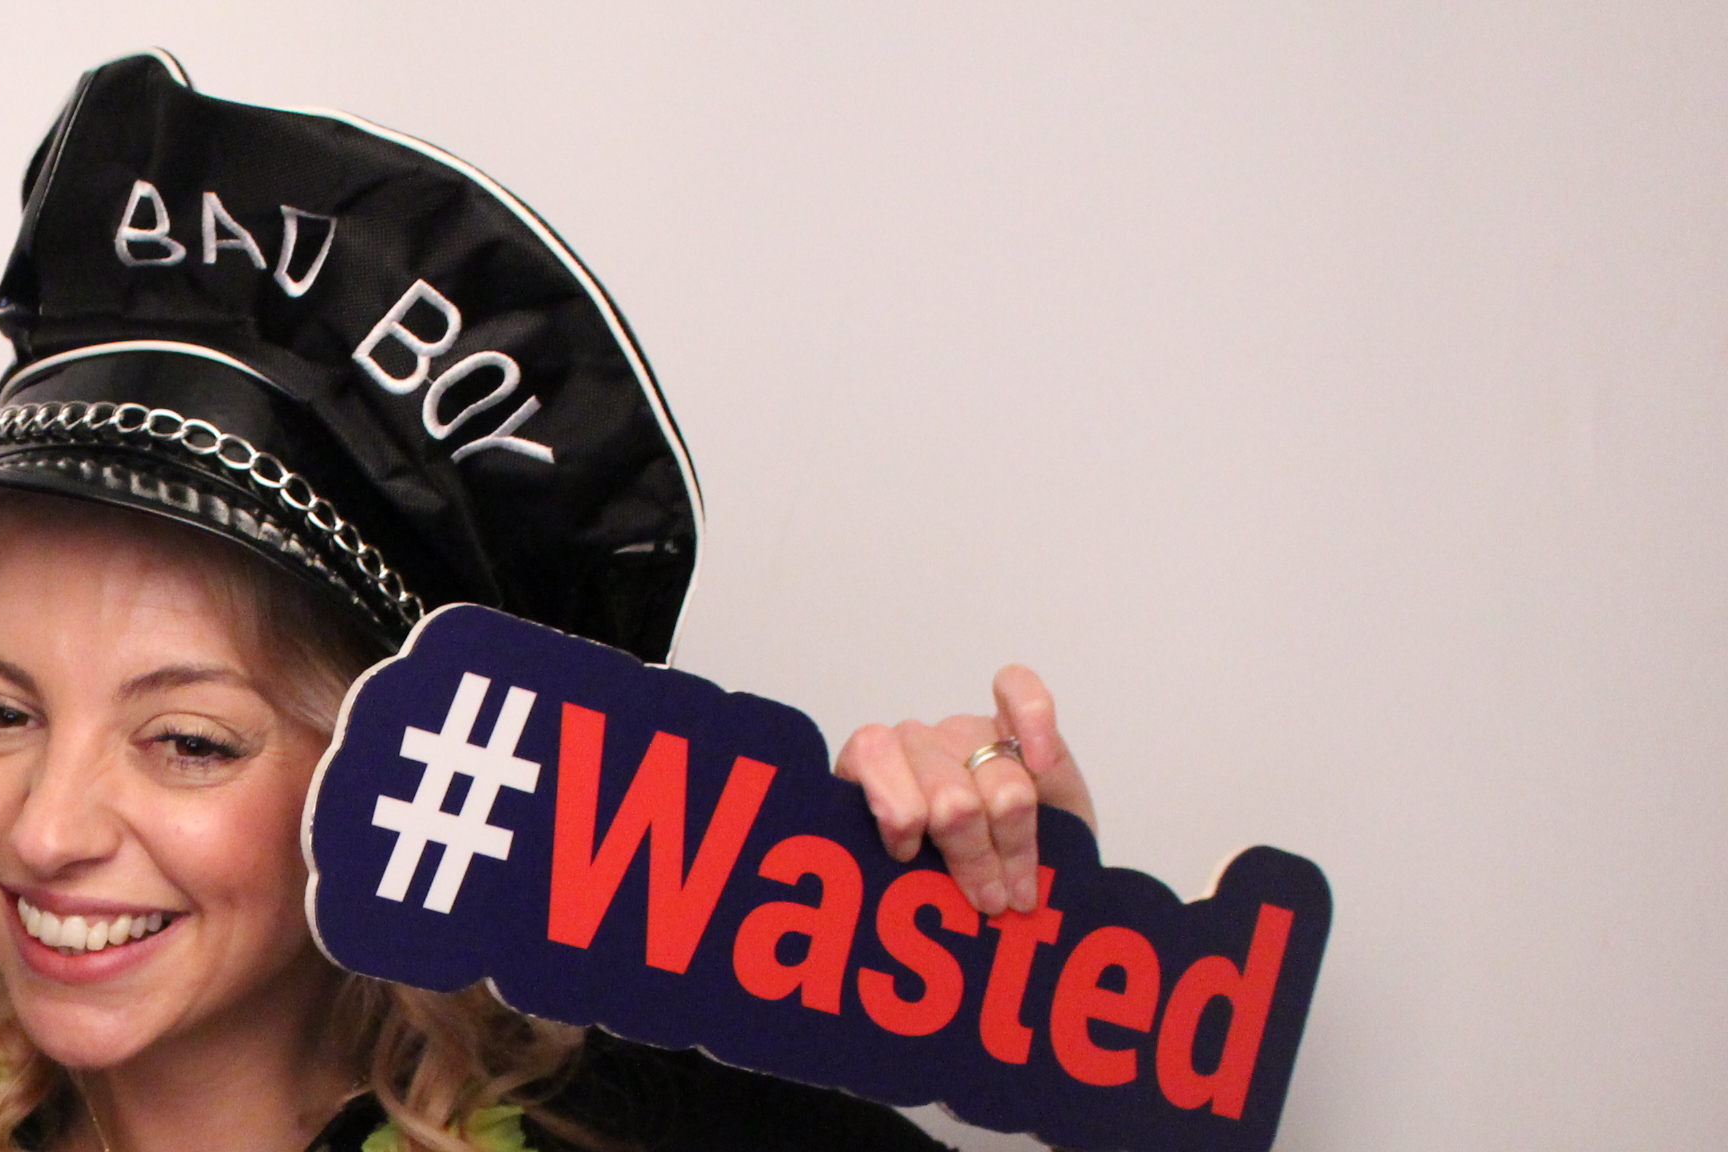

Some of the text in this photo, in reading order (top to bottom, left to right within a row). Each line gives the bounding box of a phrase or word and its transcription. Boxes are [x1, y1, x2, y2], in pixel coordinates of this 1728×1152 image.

[114, 179, 556, 465] BAD BOY
[370, 670, 1295, 1121] #Wasted
